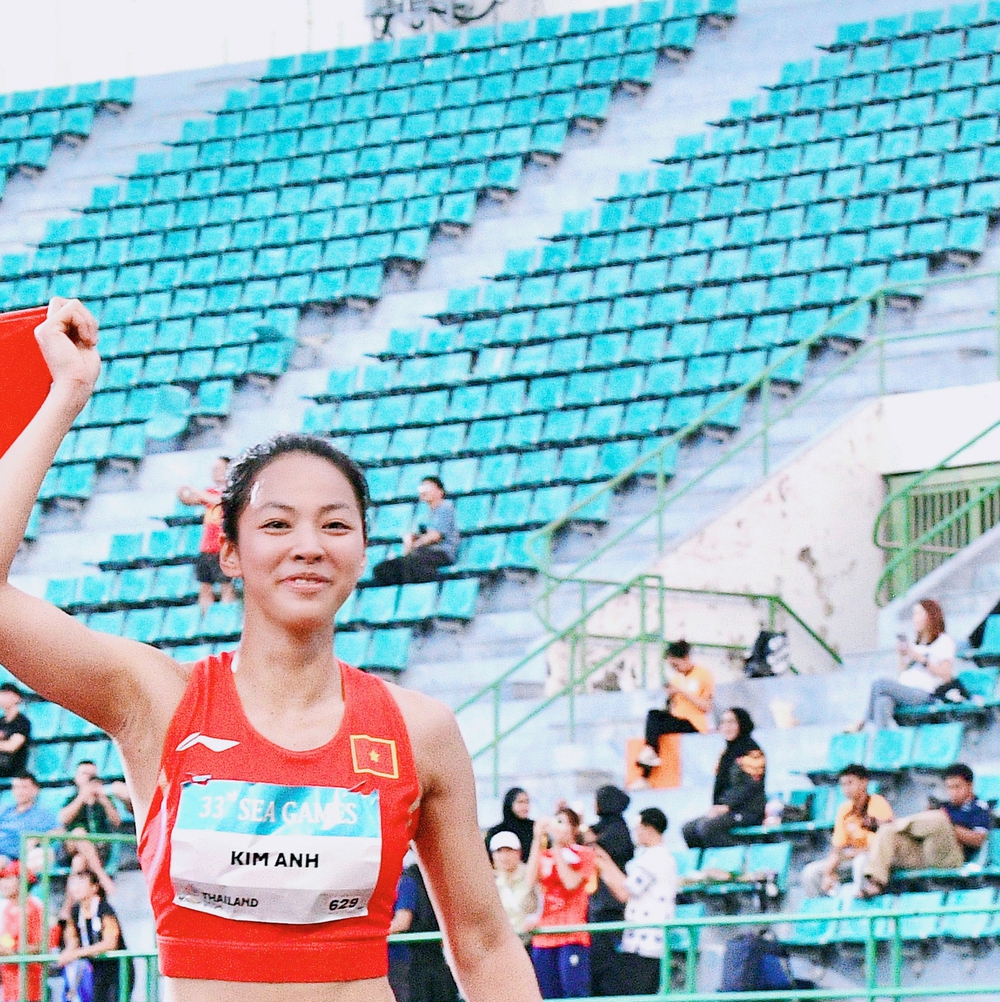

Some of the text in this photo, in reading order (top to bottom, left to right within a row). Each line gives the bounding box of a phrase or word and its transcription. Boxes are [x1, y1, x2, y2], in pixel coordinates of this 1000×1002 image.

[237, 797, 276, 823] SEA
[281, 800, 358, 825] GAMES
[231, 850, 319, 868] KIM ANH
[202, 892, 359, 911] THAILAND 629
